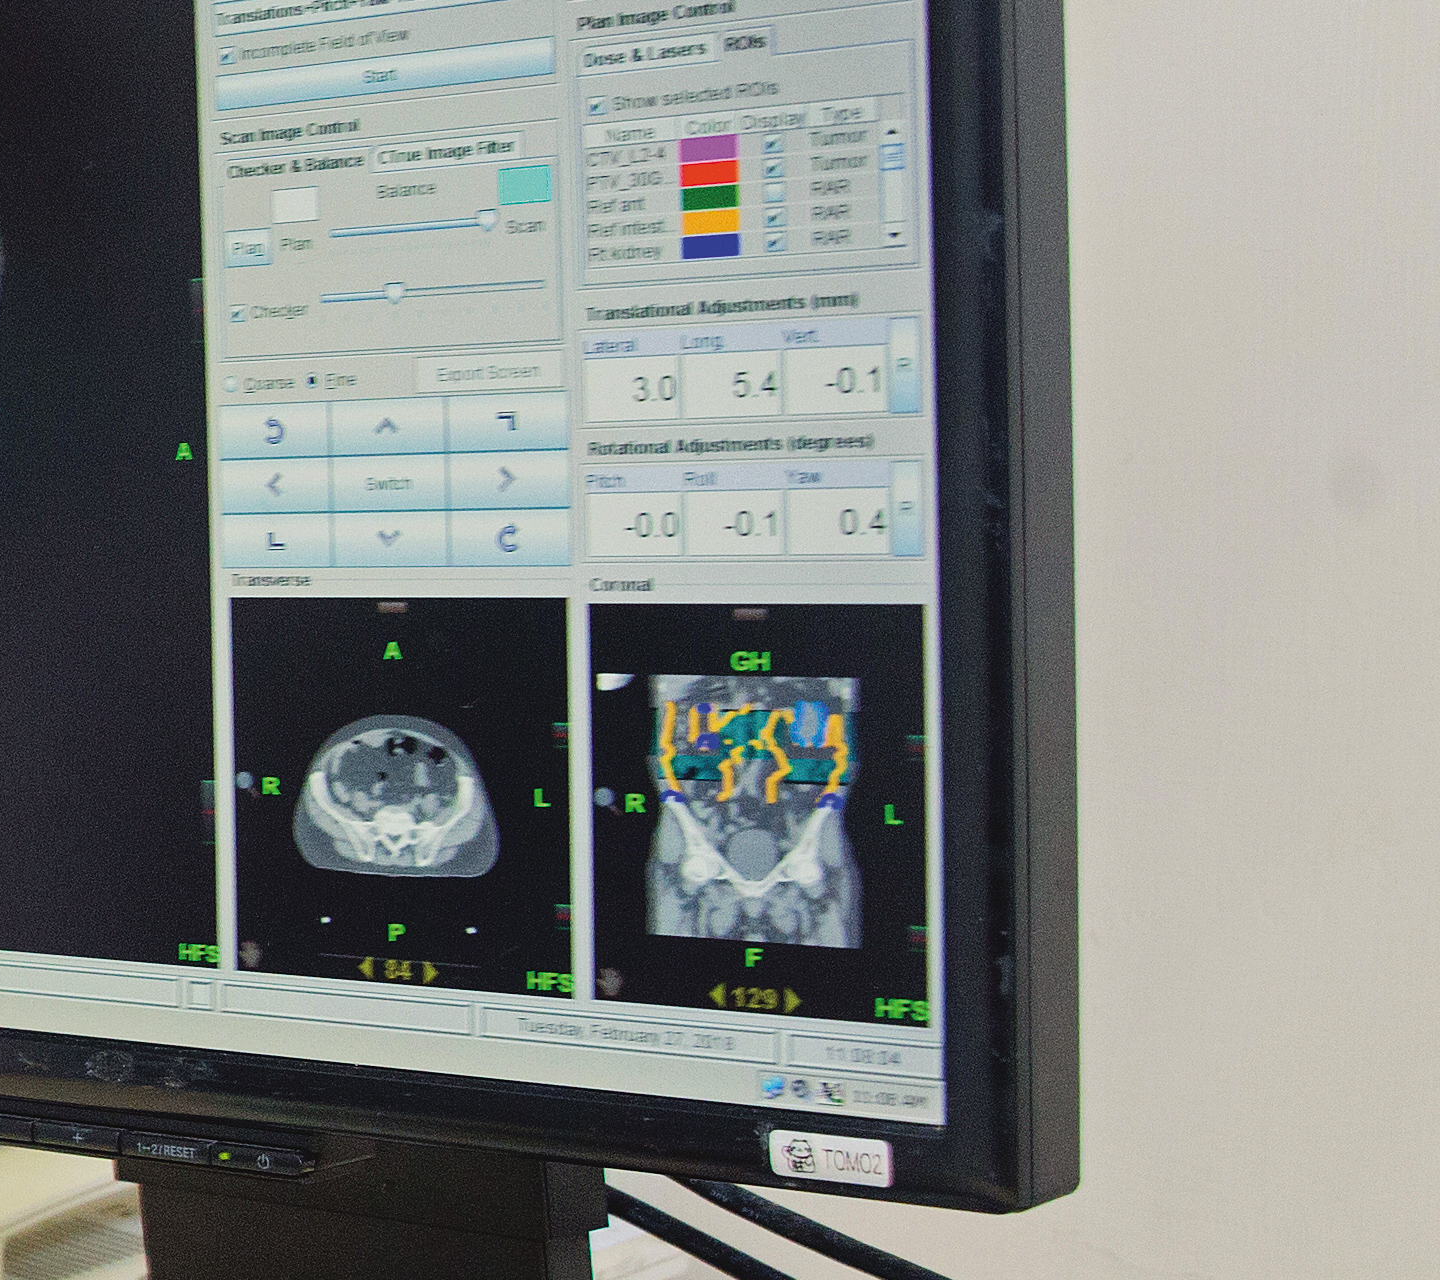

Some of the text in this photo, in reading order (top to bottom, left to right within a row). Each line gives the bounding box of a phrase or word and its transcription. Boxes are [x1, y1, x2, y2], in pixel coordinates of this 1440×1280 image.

[576, 0, 737, 31] Plan Image Control
[239, 40, 316, 62] Incomplete
[320, 35, 355, 52] Field
[723, 34, 767, 53] ROIs
[584, 41, 707, 68] Dose & Lasers
[361, 68, 398, 85] Start
[611, 93, 659, 113] Show
[662, 86, 729, 107] selected
[822, 105, 862, 124] Type
[220, 118, 361, 147] Scan Image Control
[605, 126, 655, 143] Name
[685, 118, 729, 135] Color
[427, 141, 473, 163] Image
[476, 138, 515, 157] Filter
[227, 153, 365, 180] Checker & Balance
[377, 182, 437, 200] Balance
[505, 217, 547, 235] Scan
[280, 236, 313, 252] Plan
[249, 303, 309, 320] Checker
[586, 302, 694, 321] Translational
[697, 296, 807, 317] Adjustments
[324, 372, 358, 389] Fine
[487, 363, 542, 380] Screen
[823, 366, 883, 394] -0.1
[632, 375, 677, 402] 3.0
[732, 371, 780, 398] 5.4
[174, 442, 193, 461] A
[586, 432, 875, 456] Rotational Adjustments (degrees)
[365, 476, 414, 492] Switch
[623, 511, 680, 538] -0.0
[723, 510, 779, 537] -0.1
[839, 508, 889, 536] 0.4
[231, 572, 311, 588] Transverse
[589, 577, 655, 593] Coronal
[382, 641, 403, 660] A
[730, 650, 771, 672] GH
[261, 776, 281, 796] R
[534, 787, 551, 808] L
[624, 792, 646, 813] R
[884, 803, 904, 825] L
[388, 923, 406, 941] P
[744, 947, 764, 967] F
[525, 970, 575, 993] HFS
[874, 997, 930, 1021] HFS
[822, 1148, 883, 1176] TOMO2
